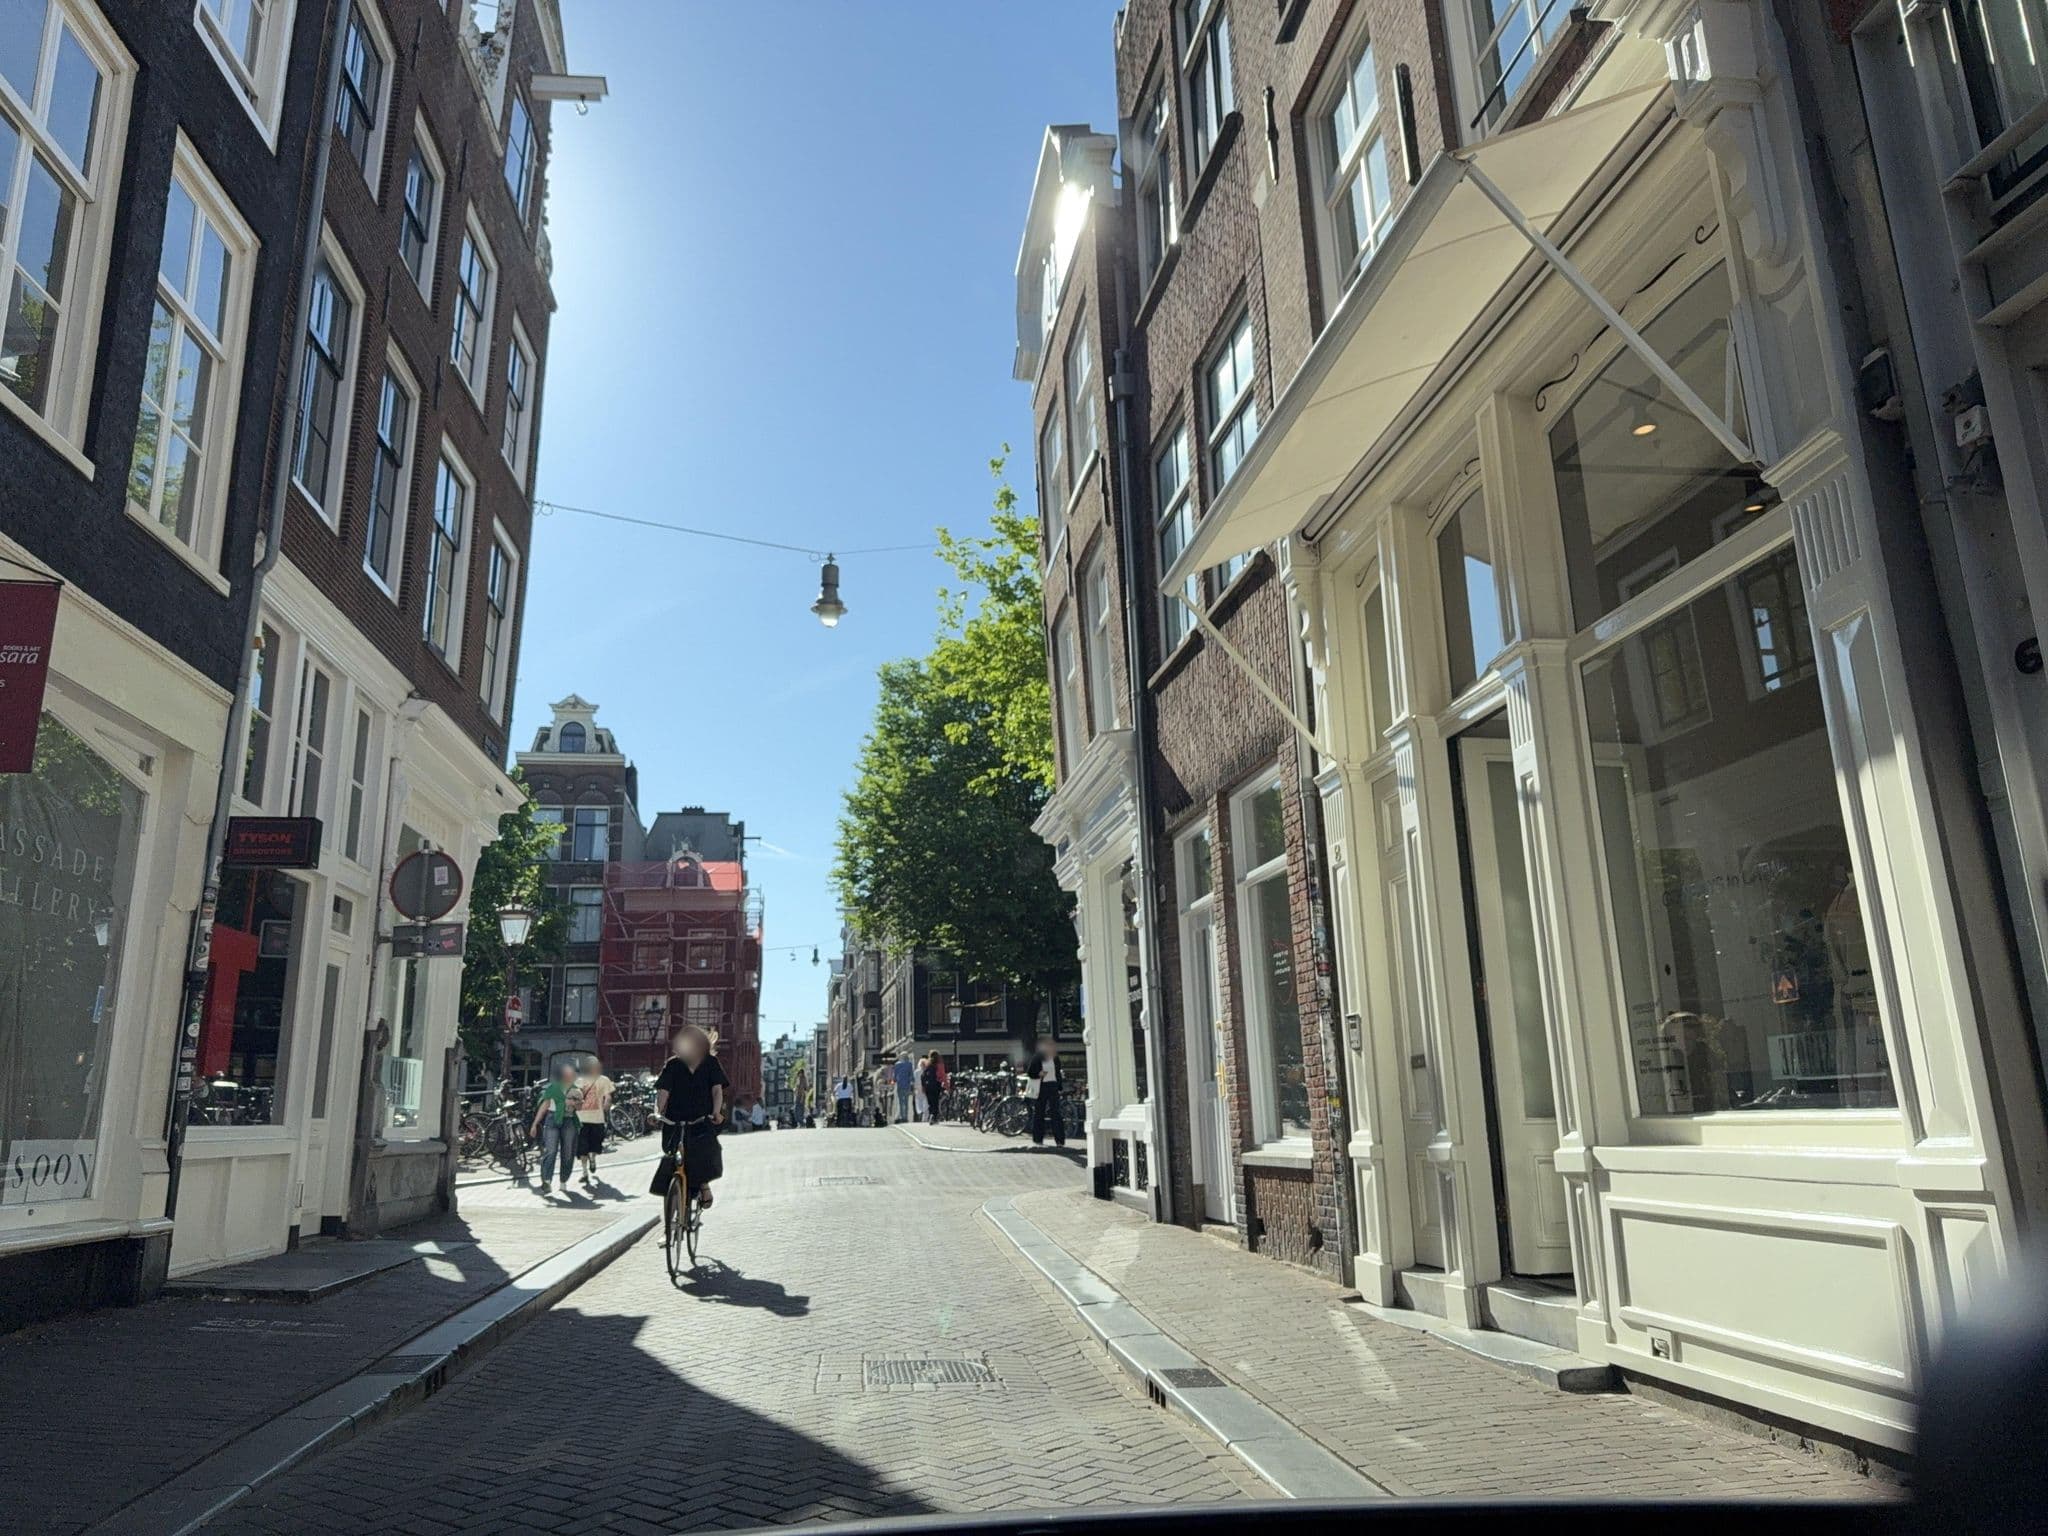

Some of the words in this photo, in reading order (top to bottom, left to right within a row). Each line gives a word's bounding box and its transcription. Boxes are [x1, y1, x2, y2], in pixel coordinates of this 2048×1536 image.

[239, 832, 293, 843] TYSON
[1334, 844, 1342, 862] 8
[12, 1153, 92, 1189] SOON
